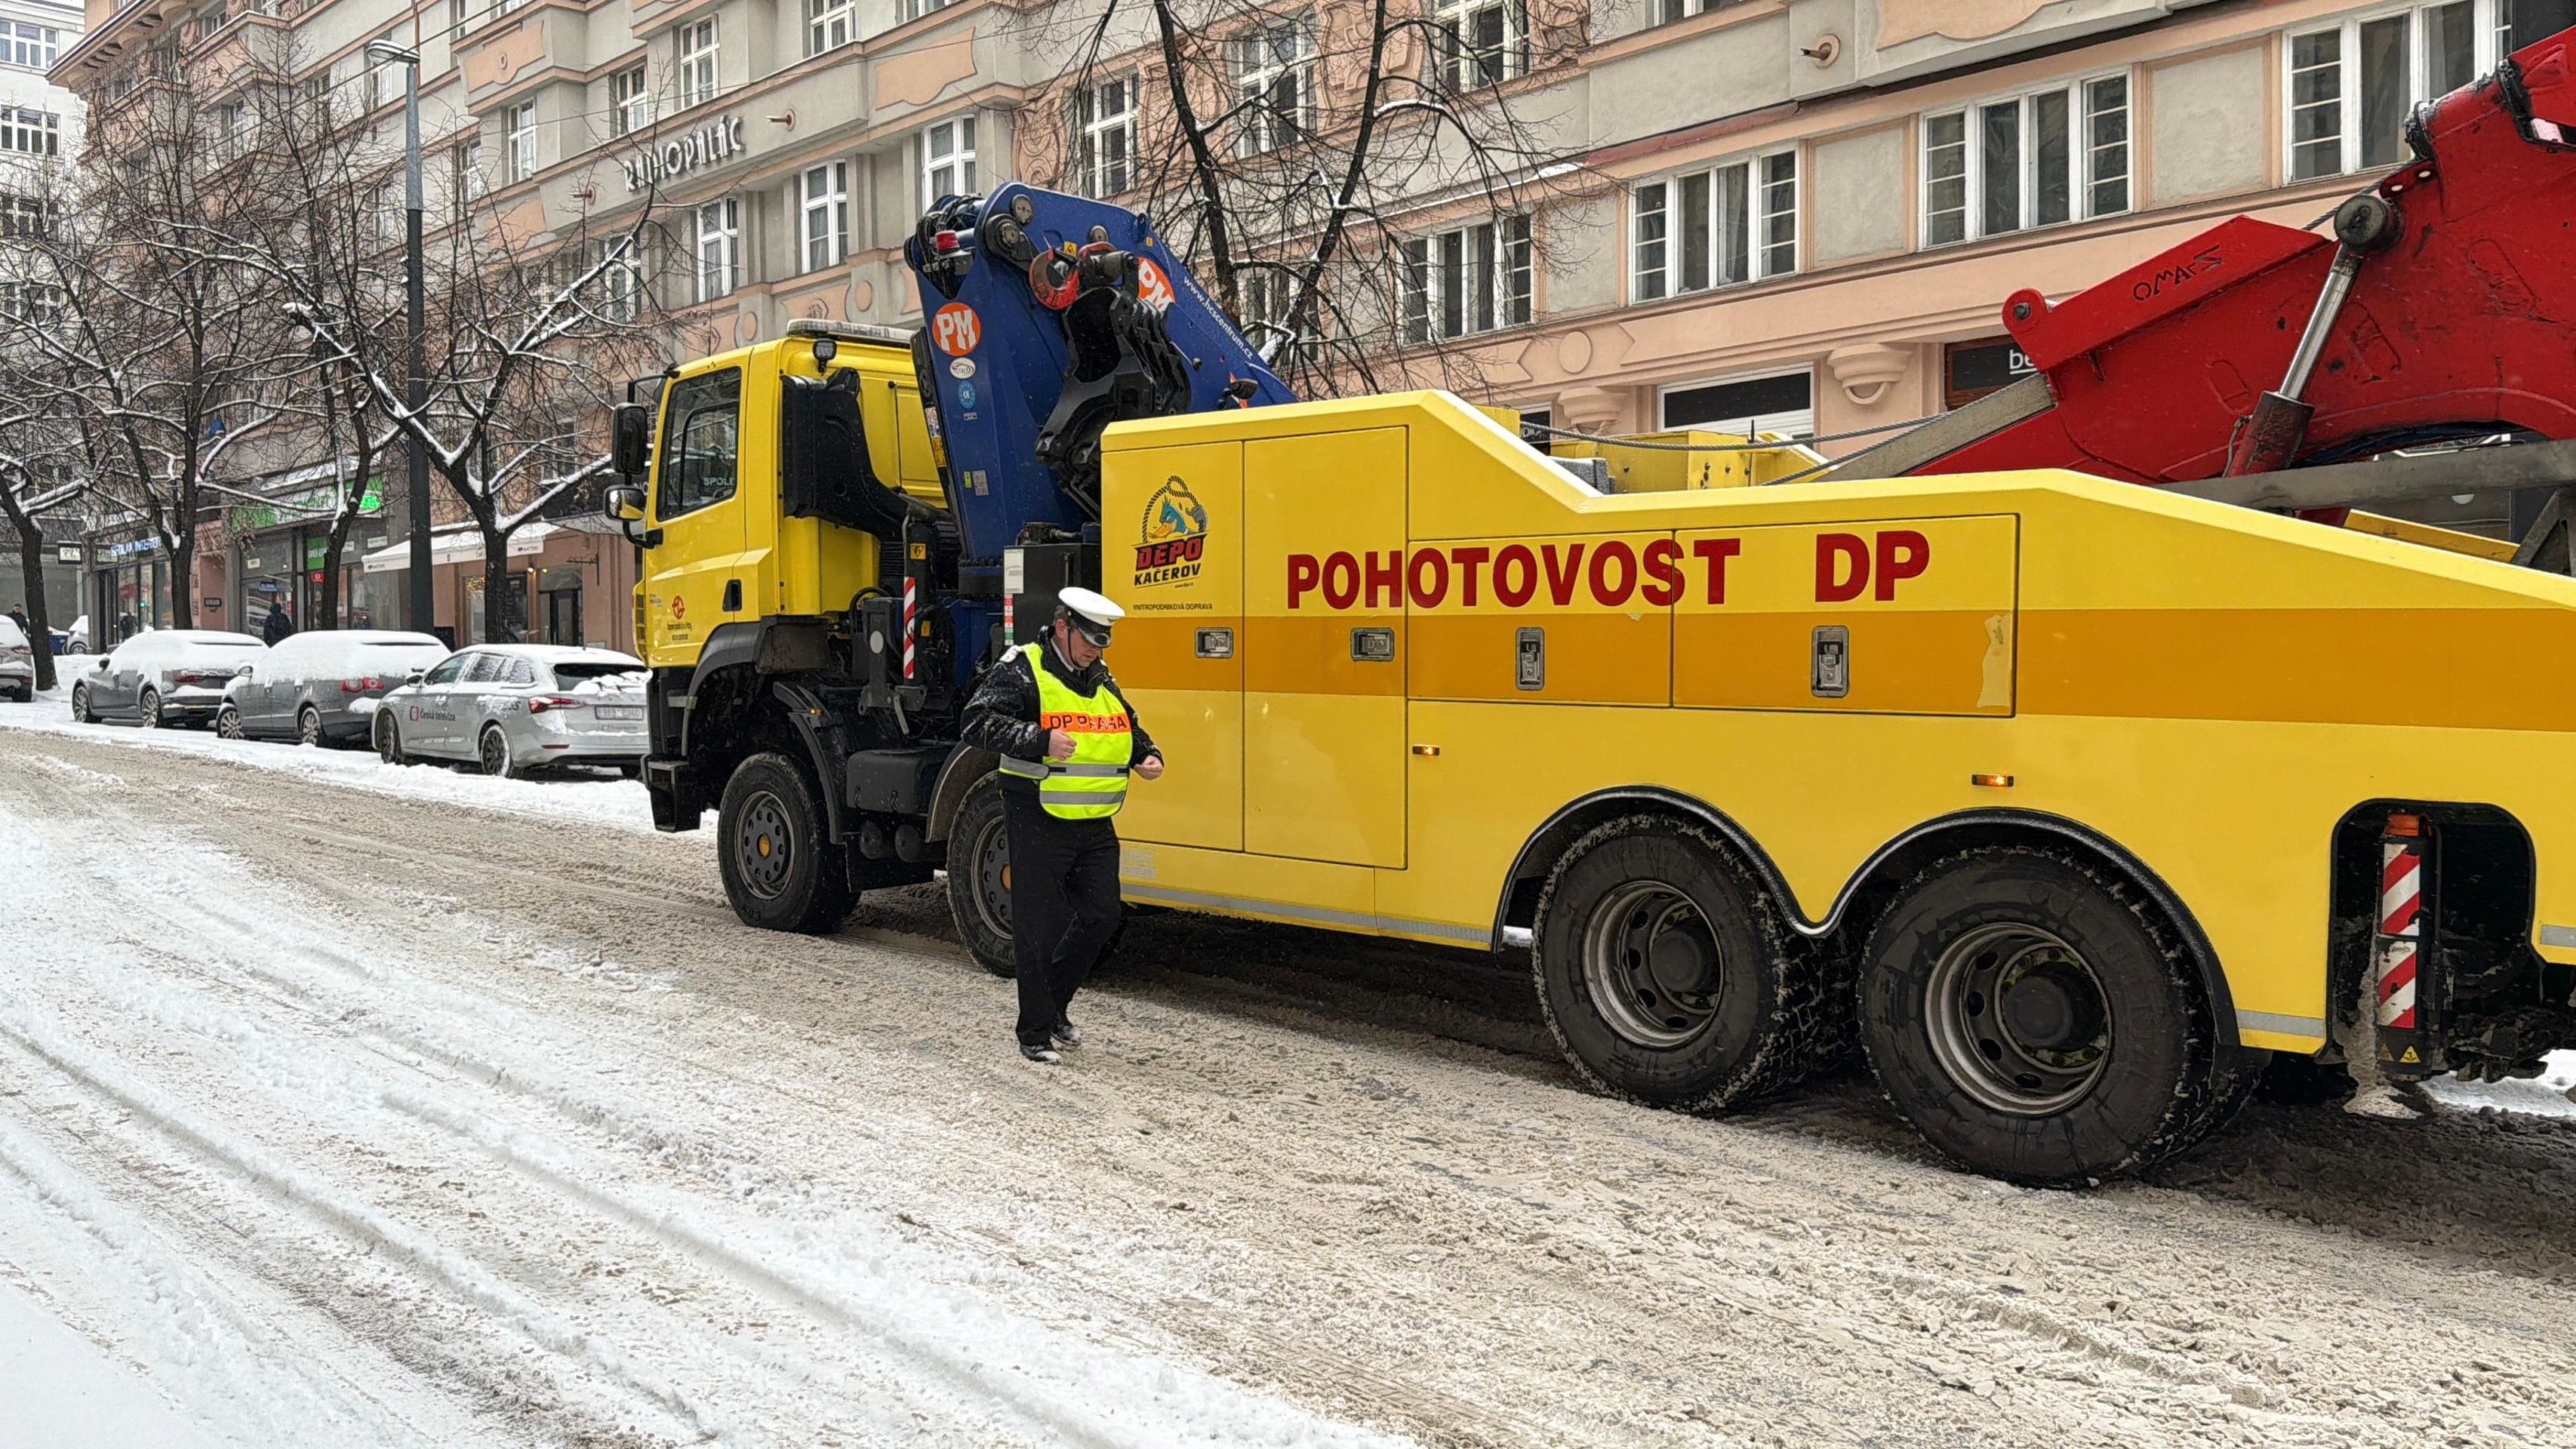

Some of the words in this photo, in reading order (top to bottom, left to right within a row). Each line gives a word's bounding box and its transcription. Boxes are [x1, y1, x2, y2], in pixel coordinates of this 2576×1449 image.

[936, 309, 977, 352] PM
[1183, 276, 1254, 360] www.hcscentrum.cz
[1137, 537, 1203, 569] DEPO
[1288, 537, 1741, 610] POHOTOVOST
[1814, 531, 1931, 602] DP
[1134, 563, 1202, 586] KAČEROV
[1050, 715, 1073, 729] DP
